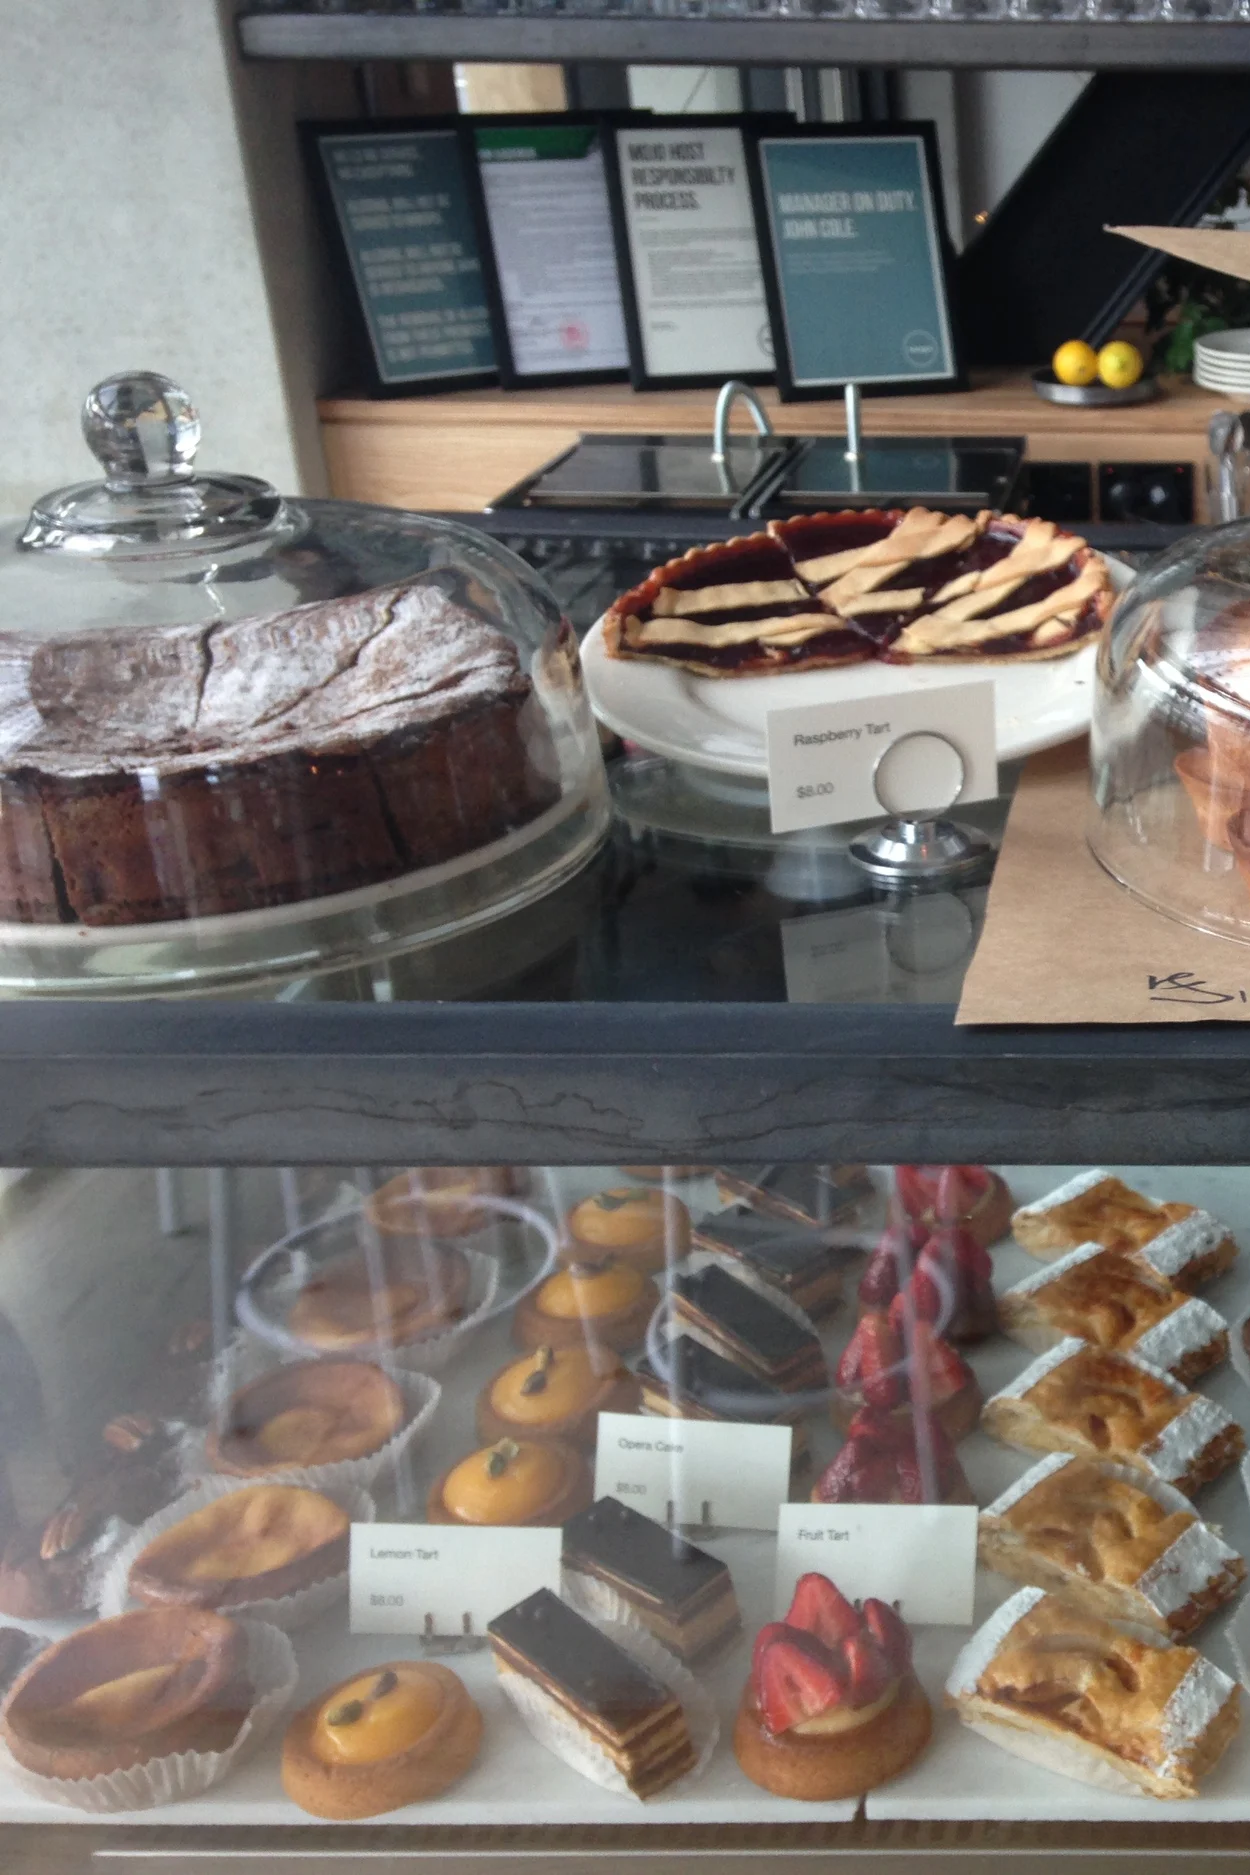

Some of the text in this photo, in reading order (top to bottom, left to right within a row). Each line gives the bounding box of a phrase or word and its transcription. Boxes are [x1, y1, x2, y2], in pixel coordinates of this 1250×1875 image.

[669, 141, 705, 161] HOST
[778, 191, 849, 214] MANAGER
[852, 191, 875, 212] ON
[794, 721, 891, 747] Raspberry Tart
[618, 1437, 652, 1453] Opera
[798, 1528, 849, 1542] Fruit Tart
[369, 1547, 439, 1560] Lemon Tart
